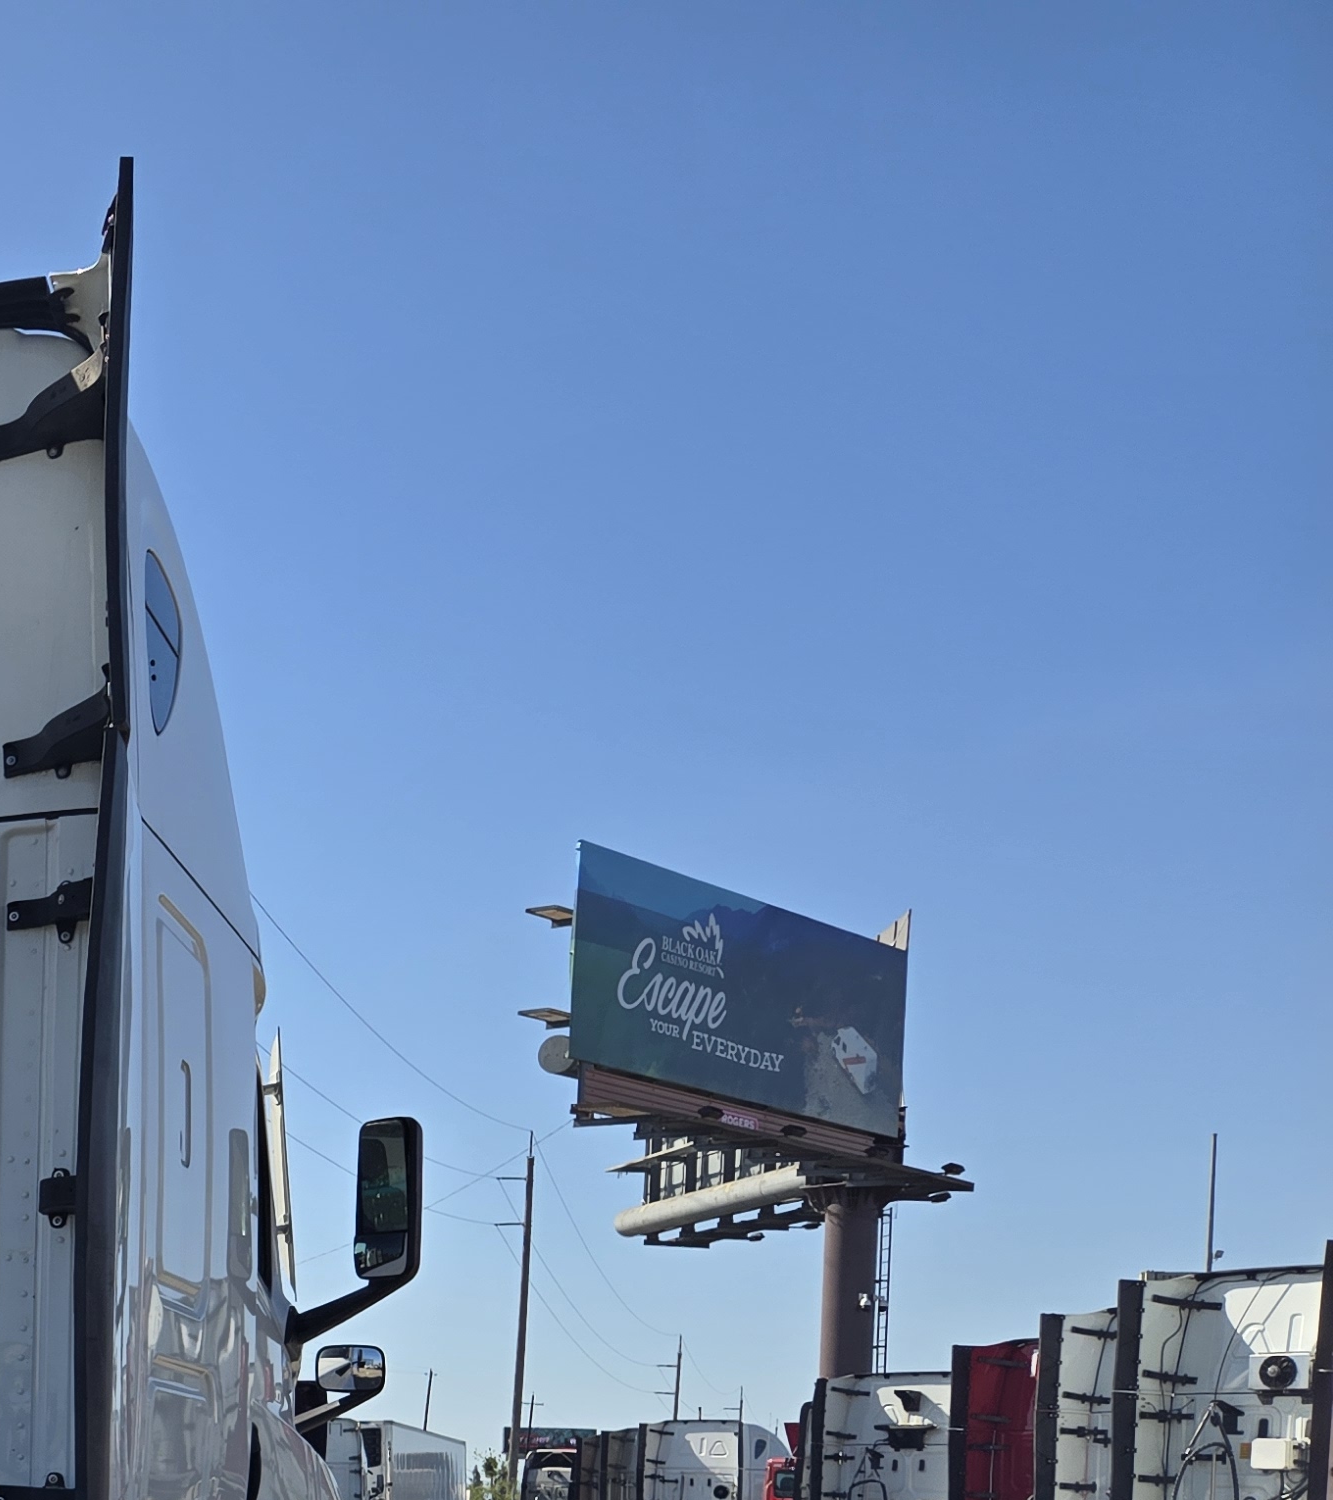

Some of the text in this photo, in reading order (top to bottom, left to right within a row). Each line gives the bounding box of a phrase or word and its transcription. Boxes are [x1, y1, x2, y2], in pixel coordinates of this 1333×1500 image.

[661, 952, 717, 977] CASINO RESORT
[662, 936, 717, 966] BLACK OAK
[617, 938, 727, 1041] Escape
[650, 1018, 784, 1072] YOUR EVERYDAY
